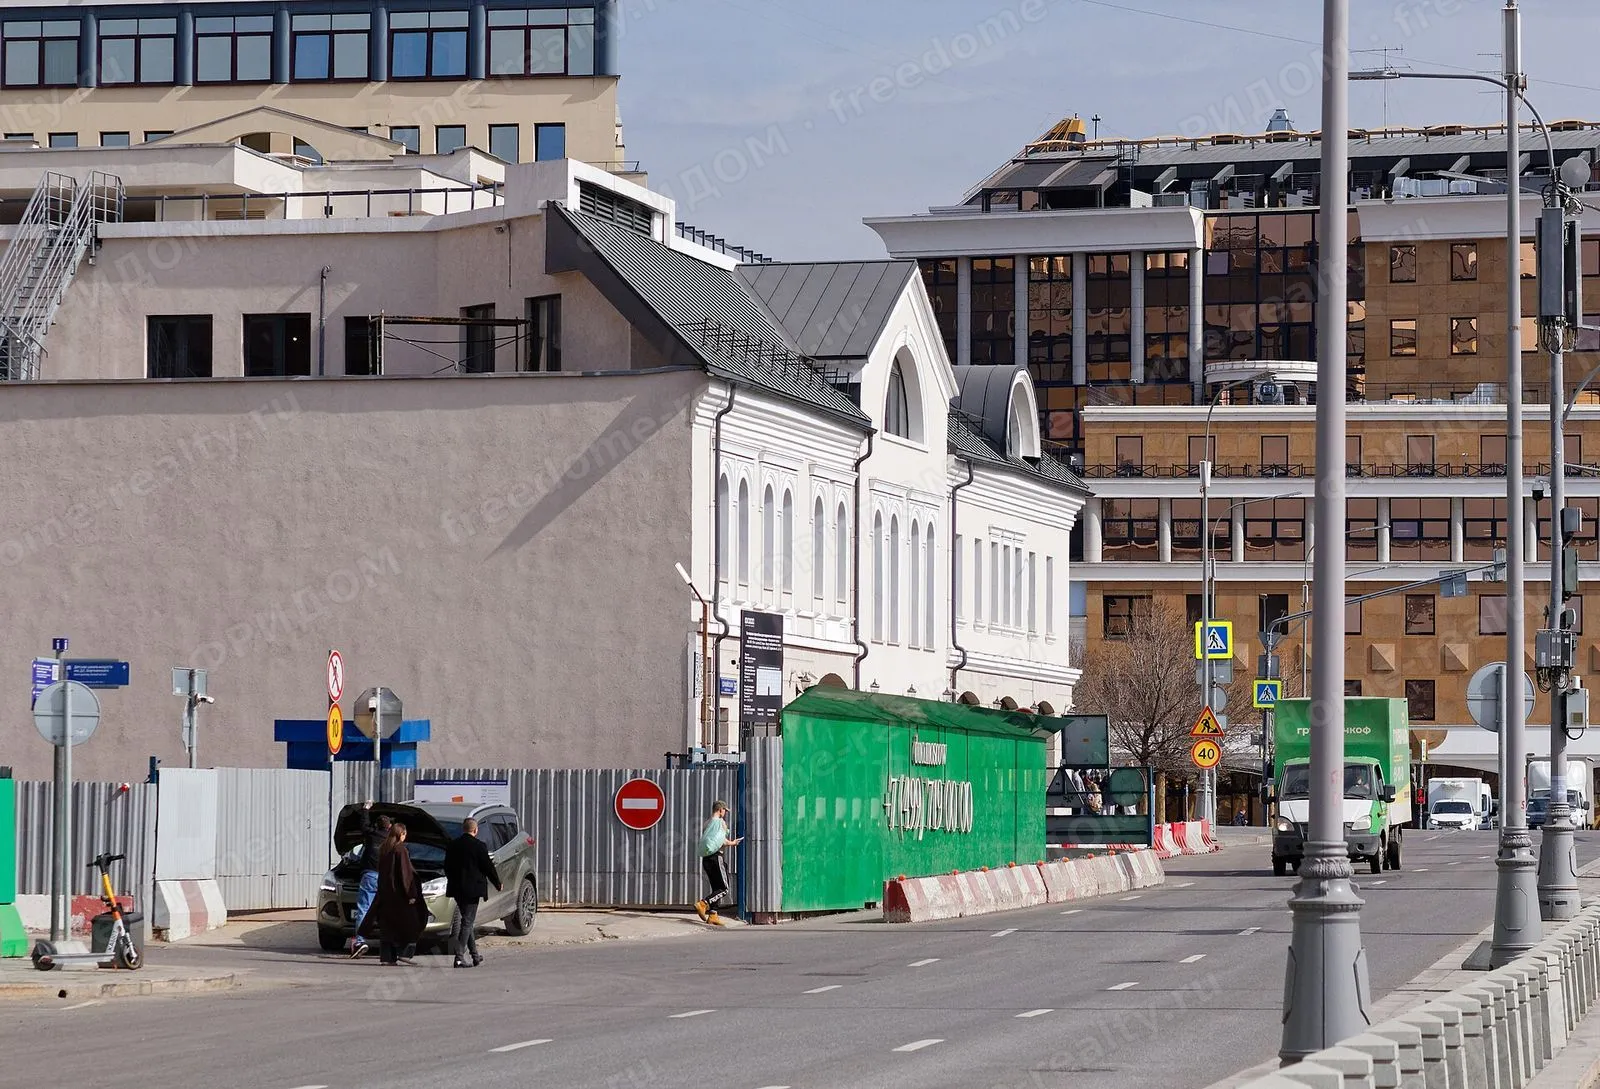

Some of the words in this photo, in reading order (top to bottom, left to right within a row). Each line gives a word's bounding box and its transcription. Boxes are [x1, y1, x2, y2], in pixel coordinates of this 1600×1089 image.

[331, 719, 339, 737] 10
[1297, 726, 1371, 736] грчкоф
[1198, 748, 1215, 760] 40
